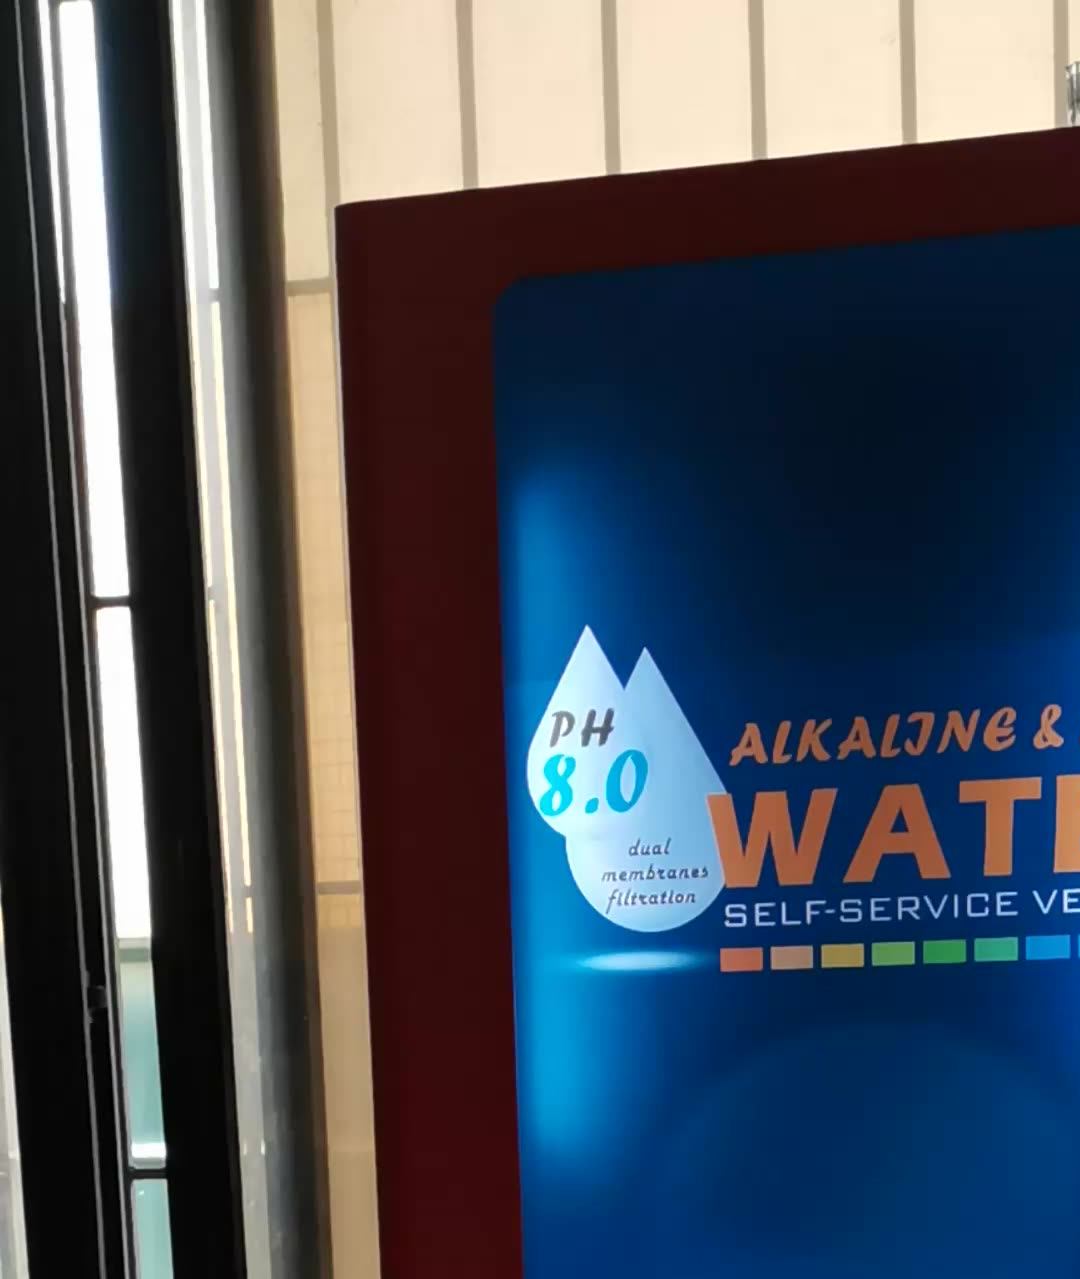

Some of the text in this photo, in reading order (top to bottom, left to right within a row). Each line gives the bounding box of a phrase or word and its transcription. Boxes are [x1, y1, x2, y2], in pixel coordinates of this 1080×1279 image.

[549, 707, 615, 748] PH
[729, 706, 1018, 767] ALKALINE
[1032, 704, 1064, 750] &
[538, 749, 649, 817] 8.0
[628, 837, 671, 857] dual
[602, 862, 709, 882] membranes
[606, 888, 696, 915] filtration
[724, 891, 1018, 928] SELF-SERVICE
